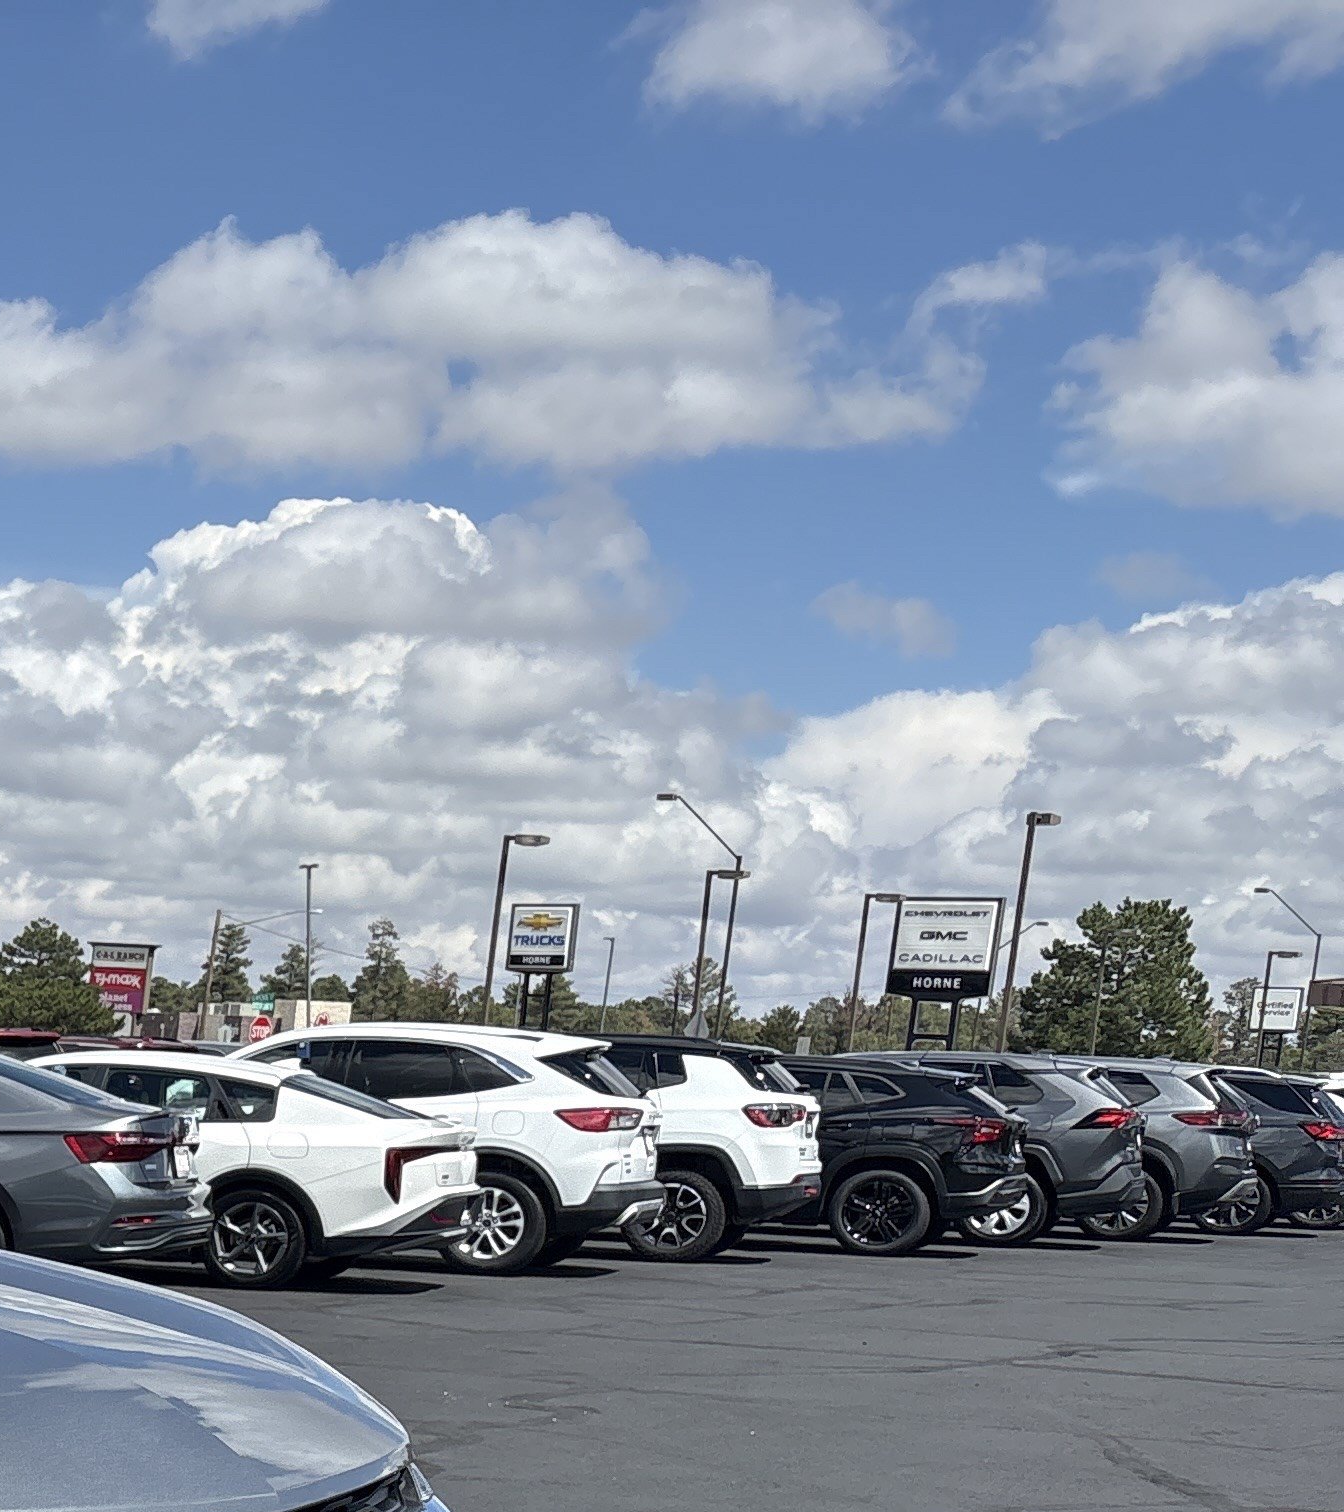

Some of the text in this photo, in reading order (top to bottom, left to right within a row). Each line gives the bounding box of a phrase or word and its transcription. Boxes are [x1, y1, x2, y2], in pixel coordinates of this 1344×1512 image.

[514, 935, 565, 946] TRUCKS
[919, 930, 968, 941] GMC
[898, 953, 984, 963] CADILLAC
[912, 976, 962, 990] HORNE
[250, 1025, 271, 1039] STOP
